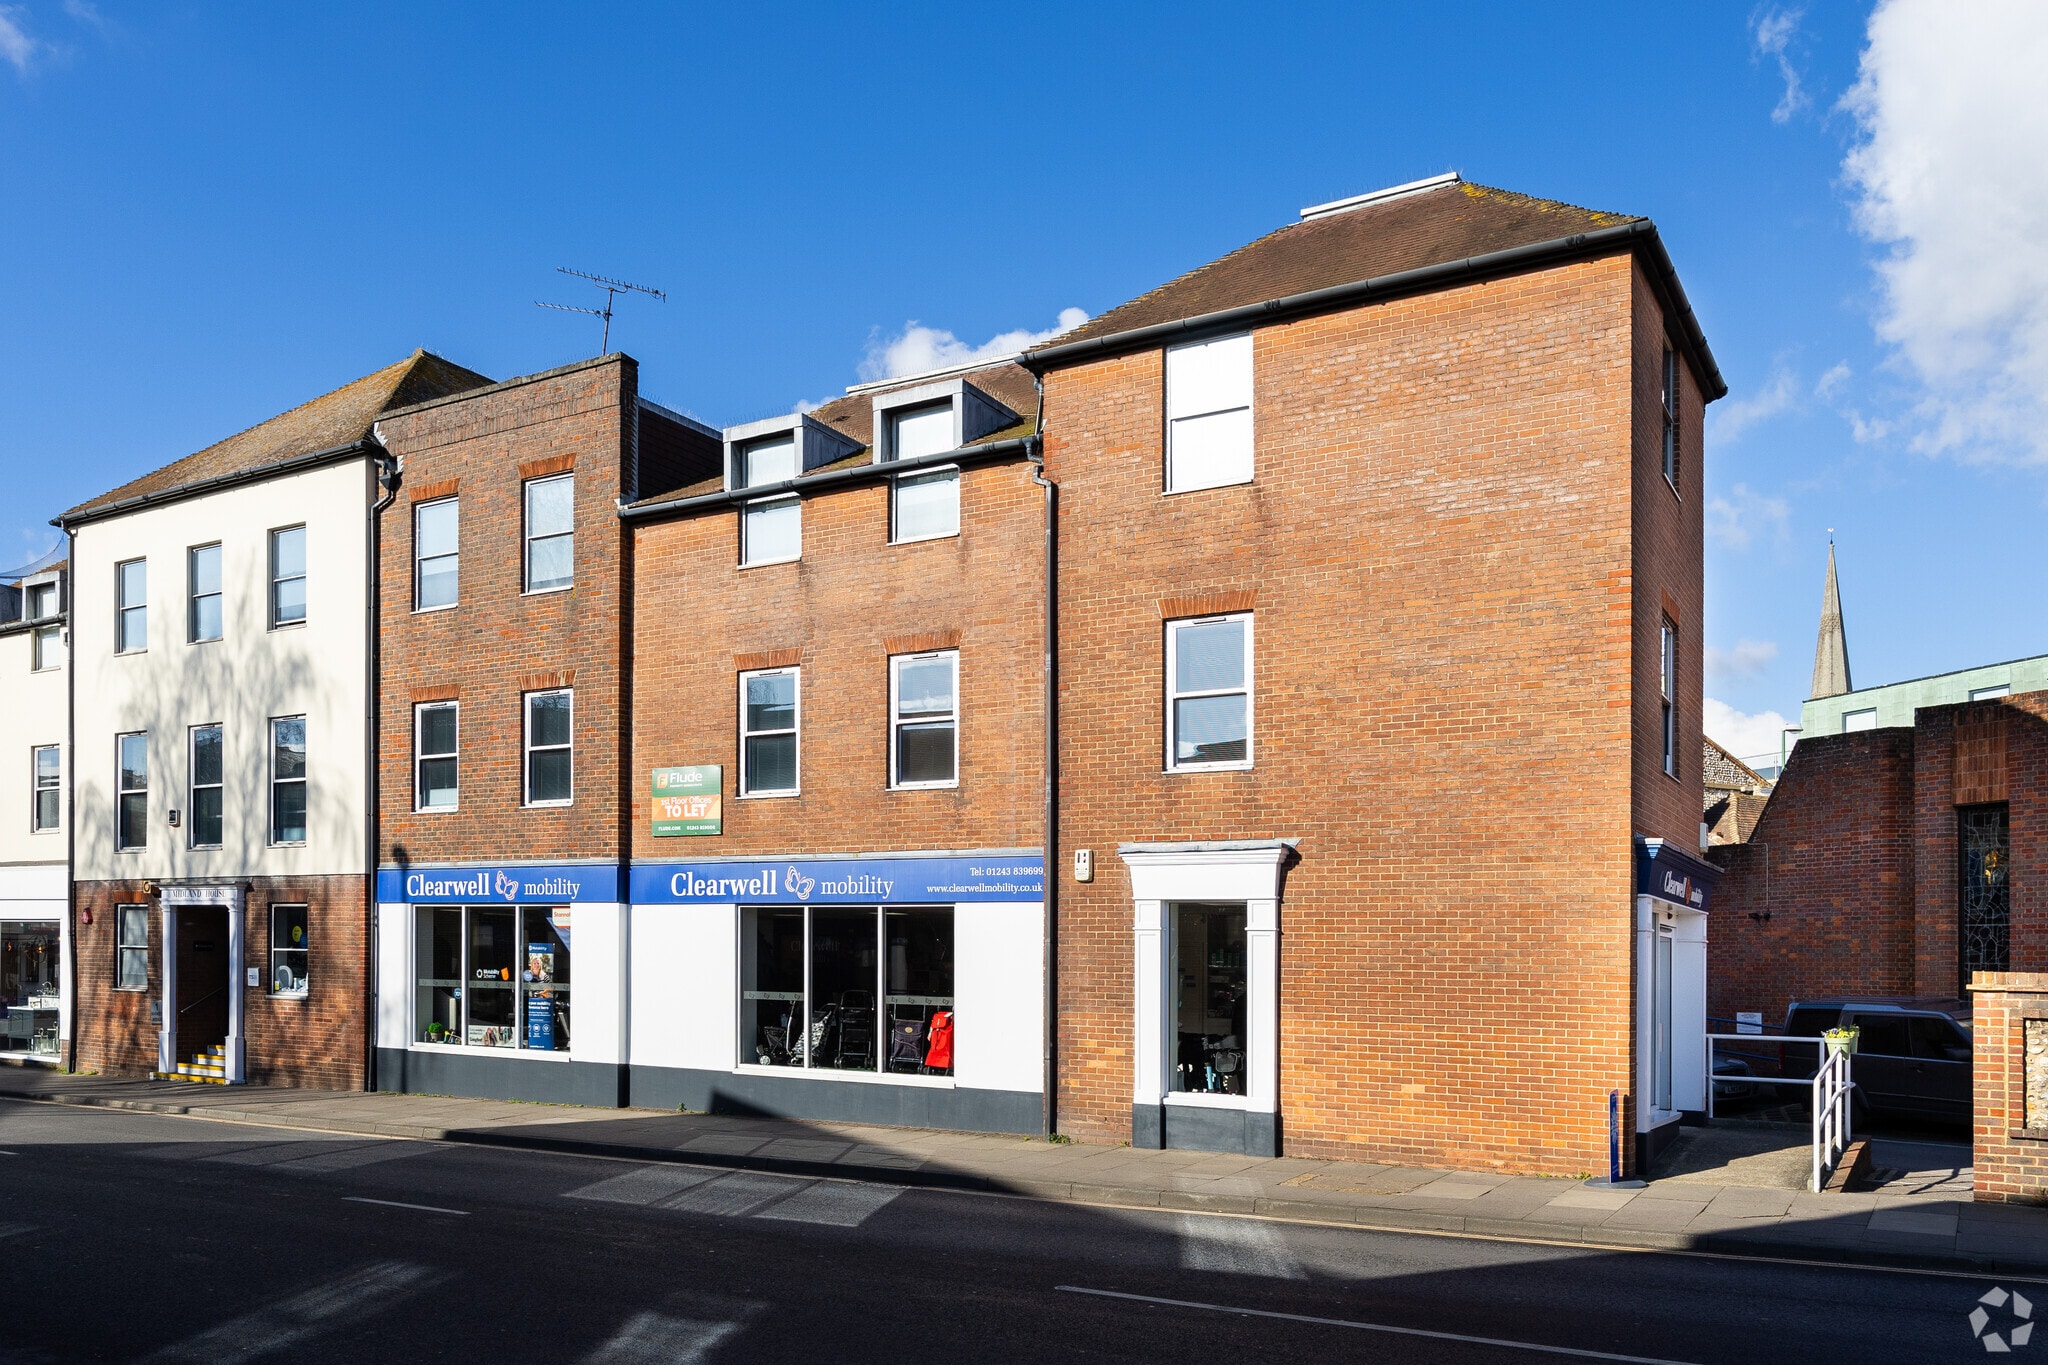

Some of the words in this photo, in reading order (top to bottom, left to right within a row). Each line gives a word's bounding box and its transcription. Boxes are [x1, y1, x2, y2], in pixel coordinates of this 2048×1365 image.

[670, 772, 702, 783] Flude
[671, 796, 688, 805] Floor
[688, 795, 712, 804] Offices
[664, 804, 682, 818] TO
[683, 803, 707, 817] LET
[970, 867, 985, 876] Tel:
[986, 867, 1011, 876] 01243
[1013, 866, 1044, 876] 839699
[406, 873, 490, 897] Clearwell
[524, 878, 581, 899] mobility
[670, 869, 778, 897] Clearwell
[820, 874, 894, 899] mobility
[926, 882, 1043, 894] www.clearwellmobility.co.uk
[1663, 870, 1688, 898] Clearwell
[172, 889, 202, 898] MIDLAND
[205, 889, 226, 898] HOUSE
